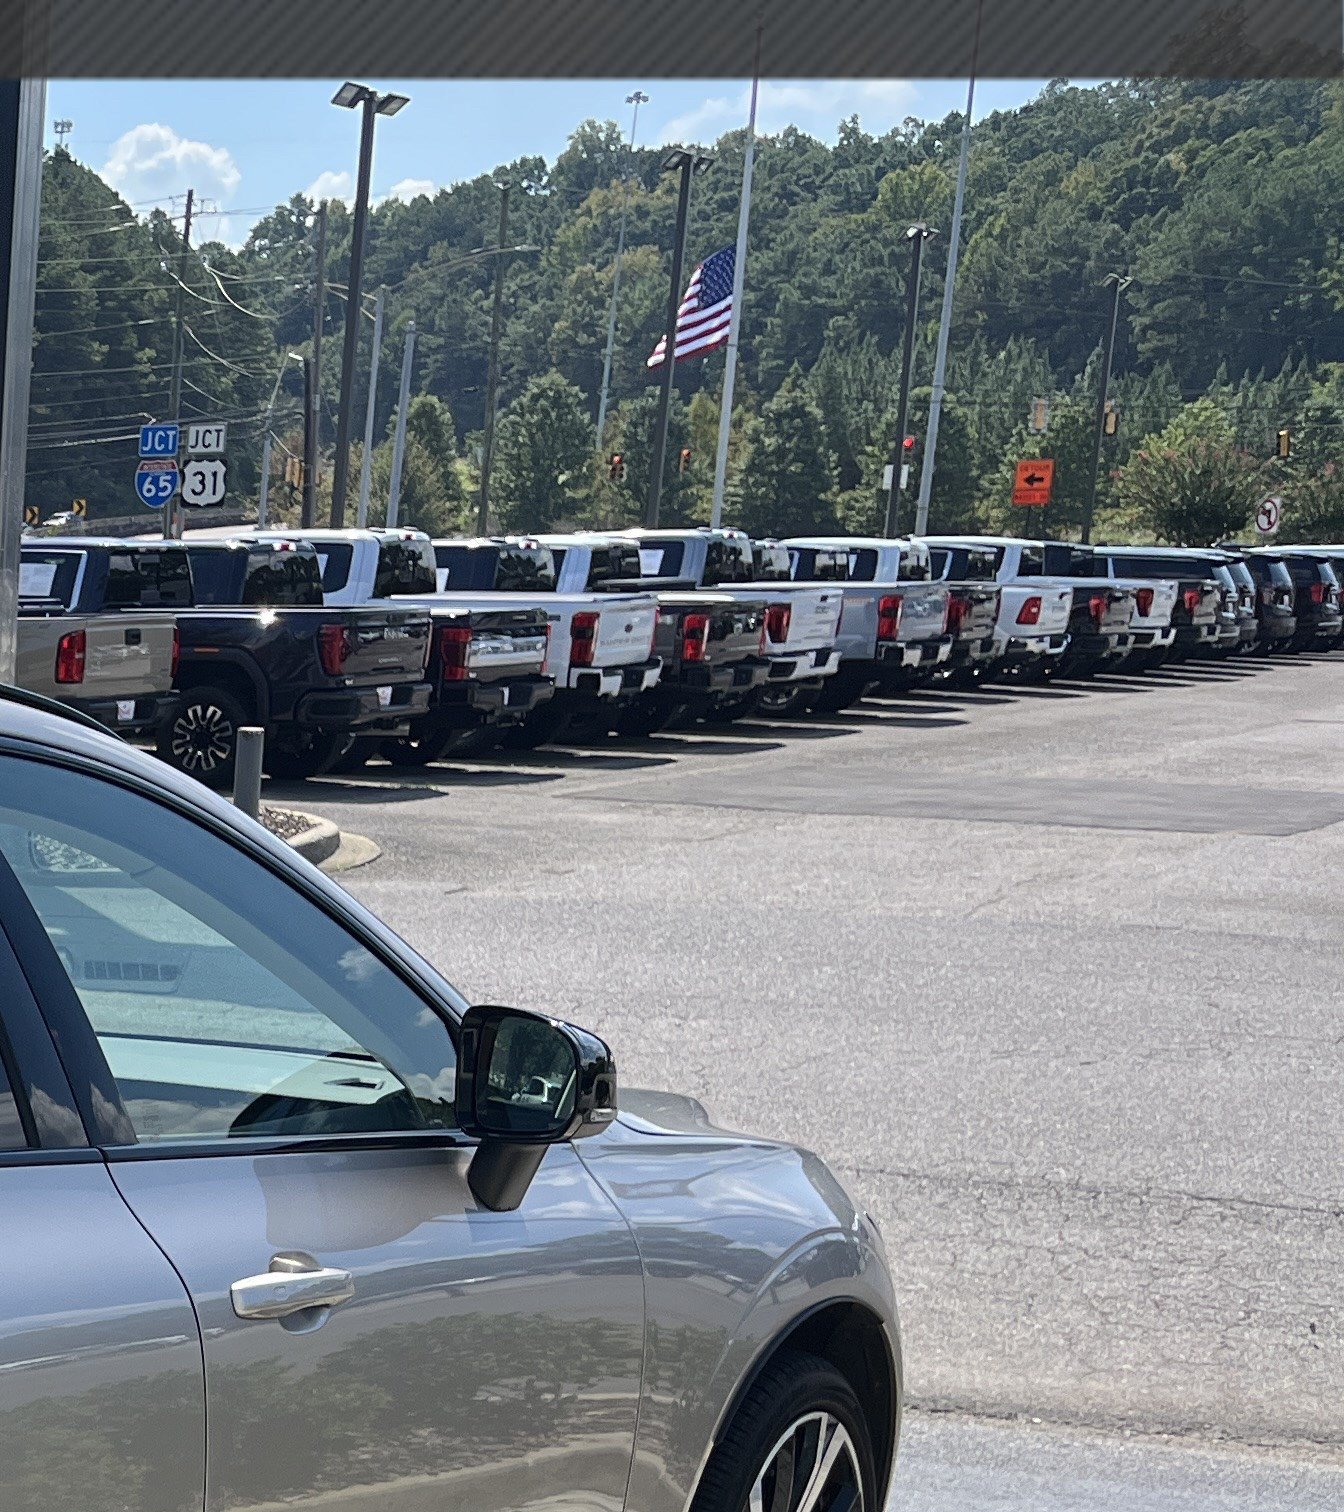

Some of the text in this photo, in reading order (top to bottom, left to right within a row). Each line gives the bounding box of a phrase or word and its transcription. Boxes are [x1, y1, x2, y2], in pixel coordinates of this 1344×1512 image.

[142, 430, 176, 451] JCT
[190, 429, 223, 449] JCT
[142, 475, 172, 497] 65
[191, 471, 217, 496] 31
